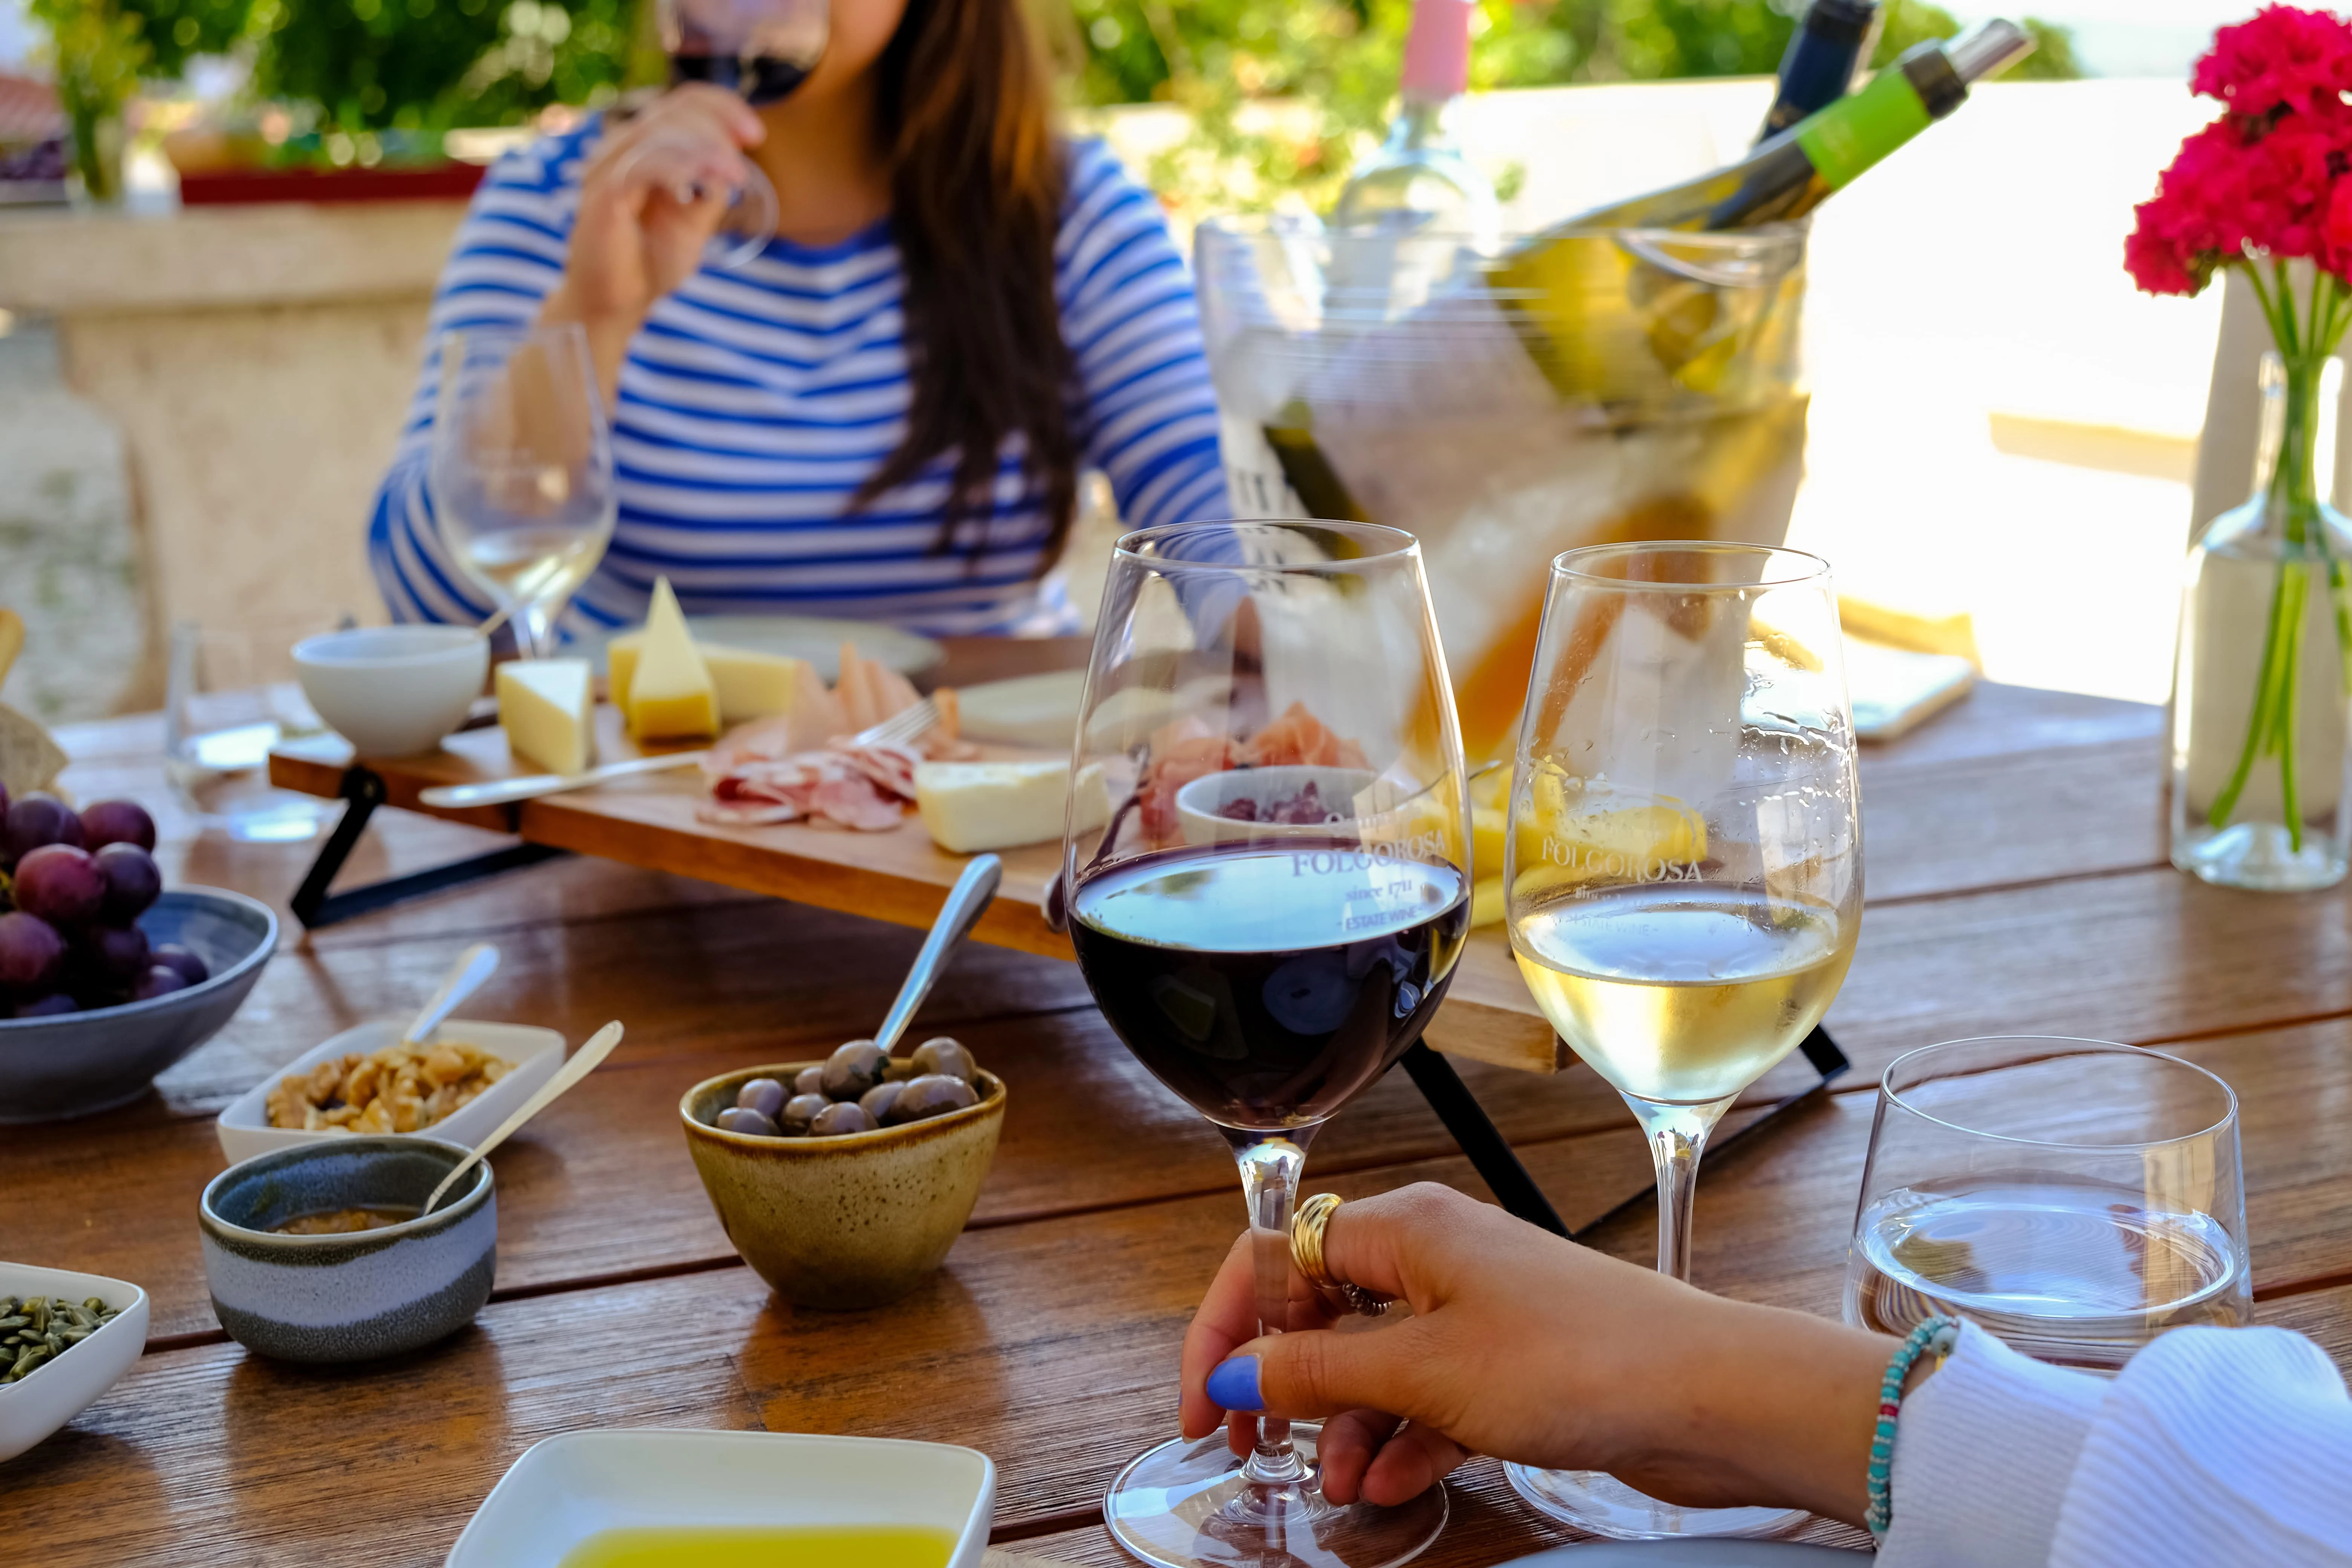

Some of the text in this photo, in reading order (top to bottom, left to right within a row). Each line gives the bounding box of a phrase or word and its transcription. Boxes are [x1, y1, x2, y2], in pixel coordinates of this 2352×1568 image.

[1292, 829, 1445, 877] FOLGOROSA
[1542, 836, 1703, 883] FOLGOROSA
[1346, 880, 1412, 901] since 1711
[1346, 906, 1416, 930] ESTATE WINE
